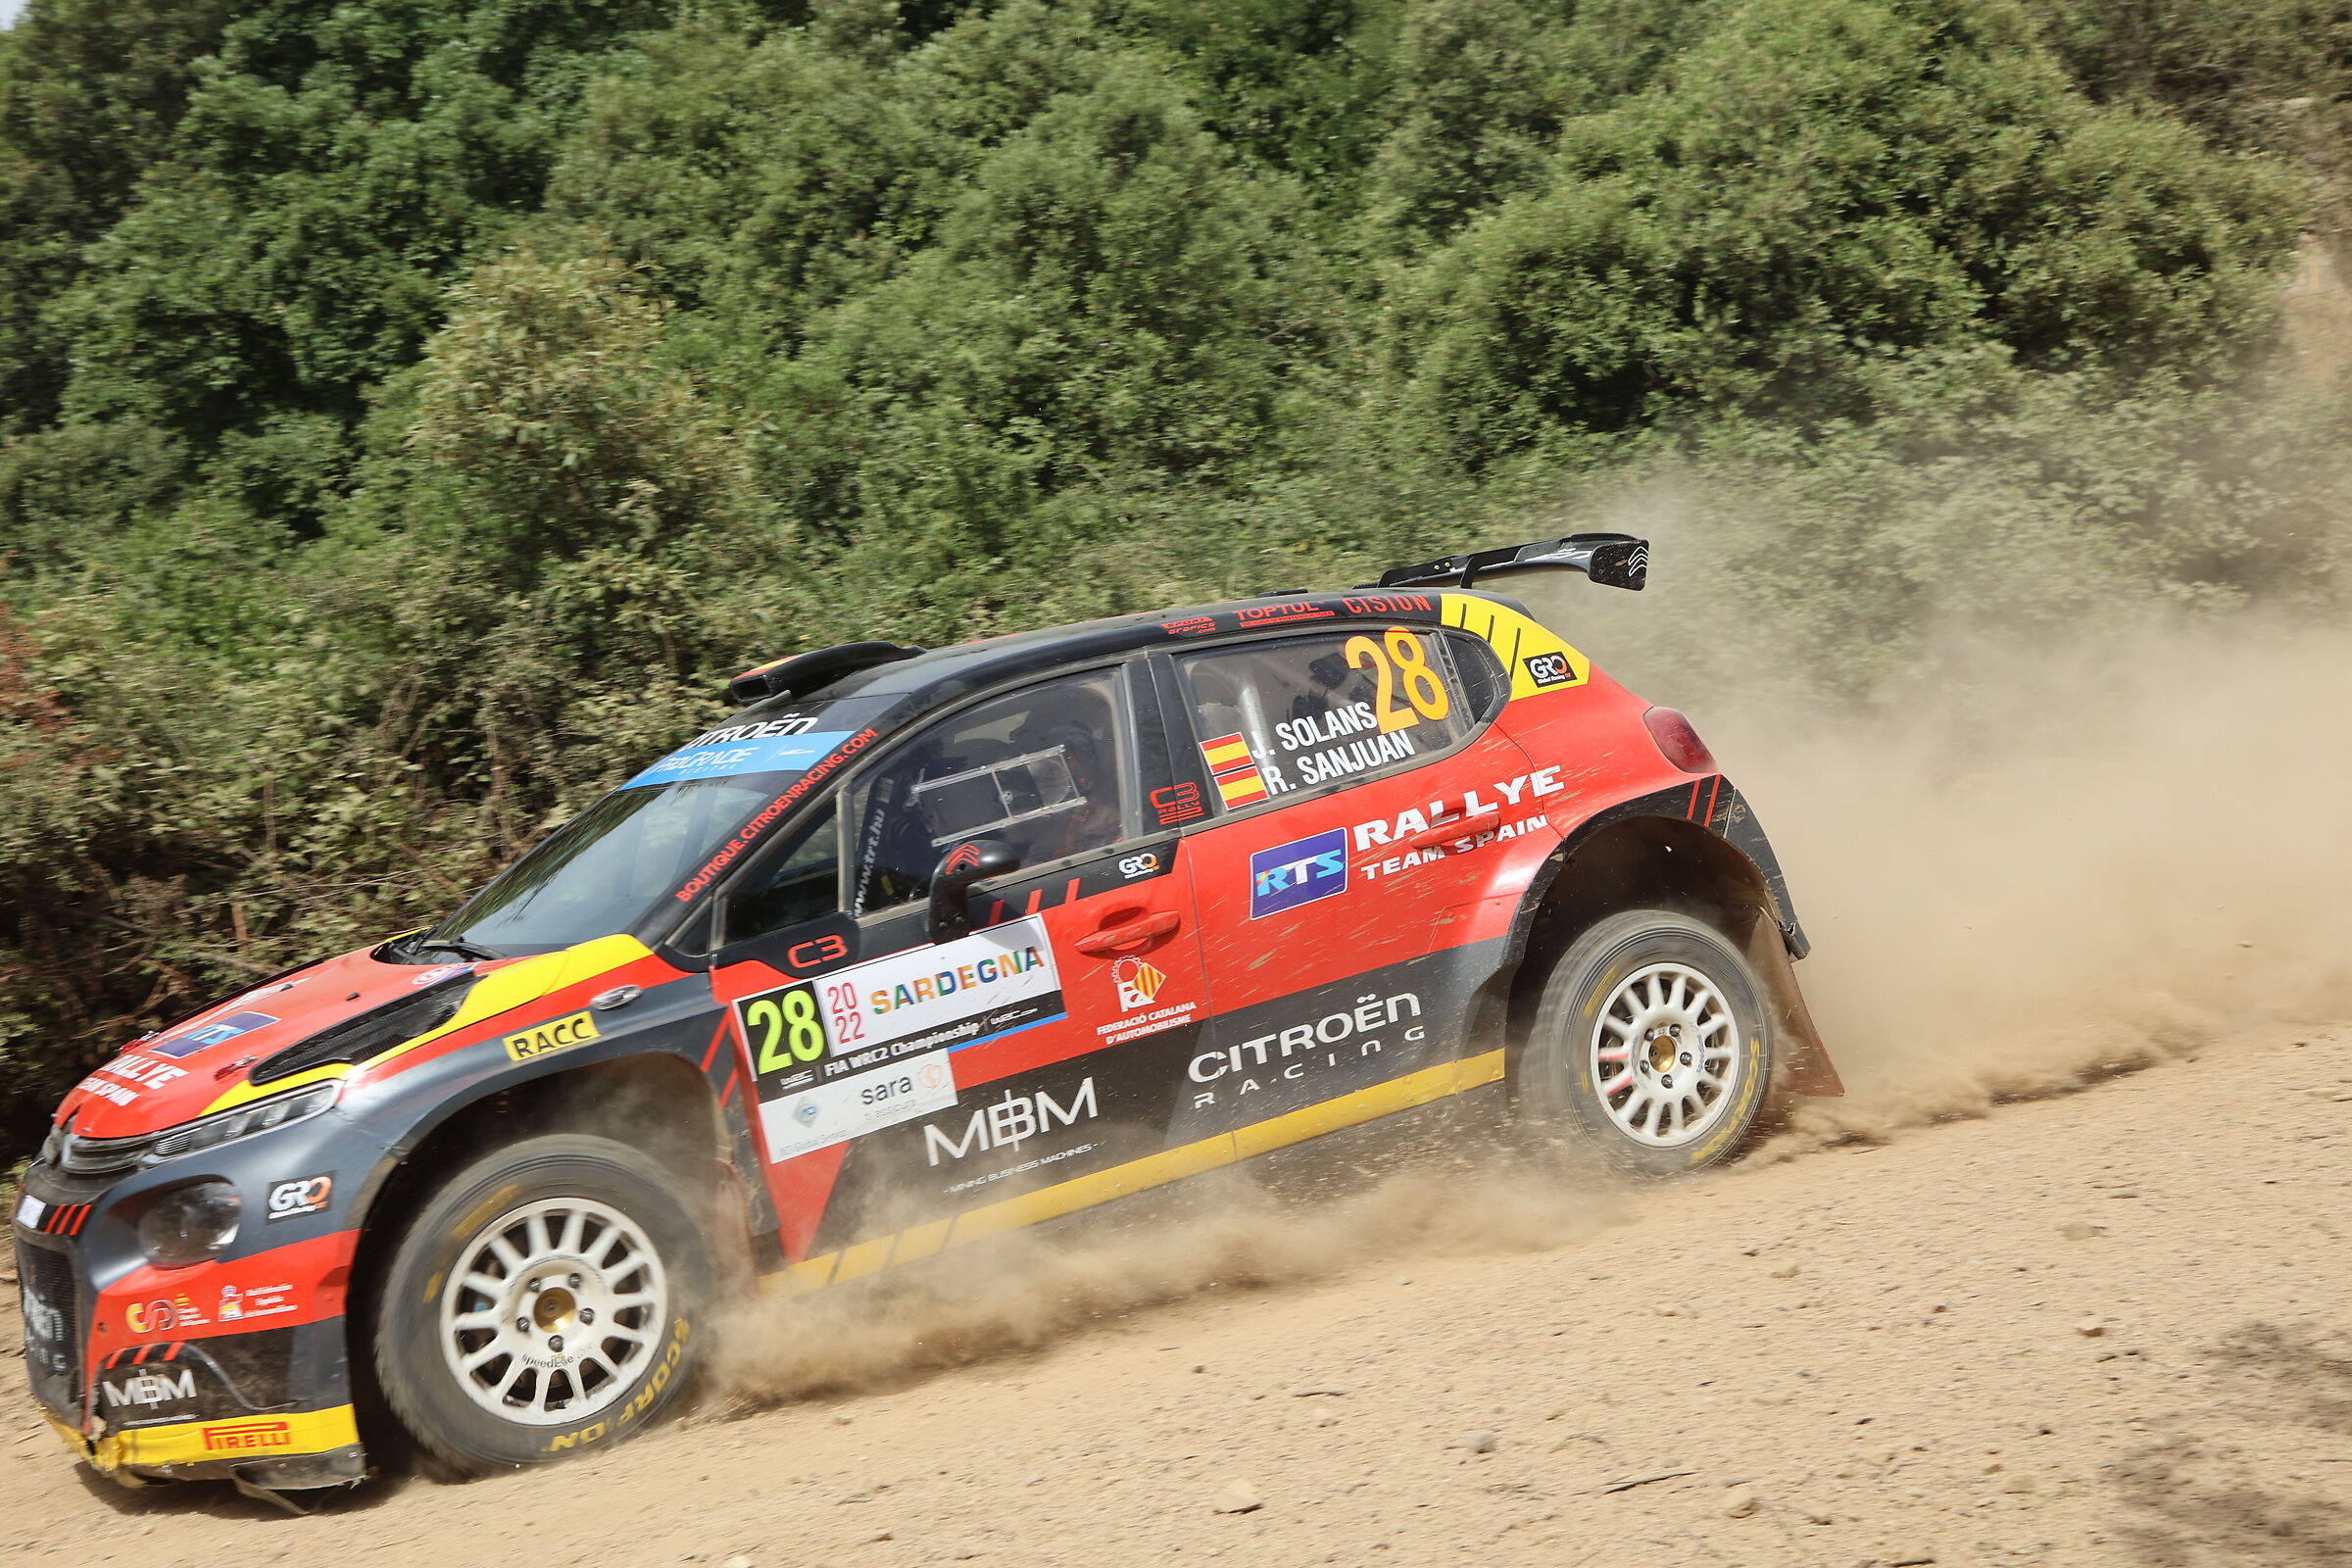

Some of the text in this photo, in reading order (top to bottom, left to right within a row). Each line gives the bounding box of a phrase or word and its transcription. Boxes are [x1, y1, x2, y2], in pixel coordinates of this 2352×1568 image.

[1232, 603, 1320, 620] TOPTUL
[1342, 595, 1432, 613] CISION
[1345, 626, 1449, 734] 28
[1530, 655, 1568, 678] GRO
[1250, 702, 1378, 760] J. SOLANS
[1261, 729, 1416, 795] R. SANJUAN
[674, 728, 879, 903] BOUTIQUE.CITROENRACING.COM
[1353, 765, 1565, 852] RALLYE
[1118, 853, 1157, 874] GRO
[1361, 814, 1548, 880] TEAM SPAIN
[1255, 850, 1346, 897] RTS
[788, 934, 848, 968] C3
[828, 982, 858, 1013] 20
[870, 946, 1045, 1015] SARDEGNA
[513, 1017, 590, 1058] RACC
[747, 990, 824, 1075] 28
[836, 1010, 865, 1044] 22
[1097, 1002, 1197, 1036] FEDERACIÓ CATALANA
[1105, 1014, 1192, 1045] D'AUTOMOBILISME
[1188, 993, 1422, 1083] CITROËN
[824, 1060, 848, 1077] FIA
[850, 1047, 889, 1069] WRC2
[890, 1020, 980, 1057] Championship
[860, 1077, 913, 1105] sara
[988, 1159, 1040, 1181] BUSINESS
[1040, 1143, 1094, 1166] MACHINES
[269, 1176, 332, 1211] GRO
[548, 1318, 690, 1451] SCORPON
[203, 1421, 291, 1451] PIRELLI
